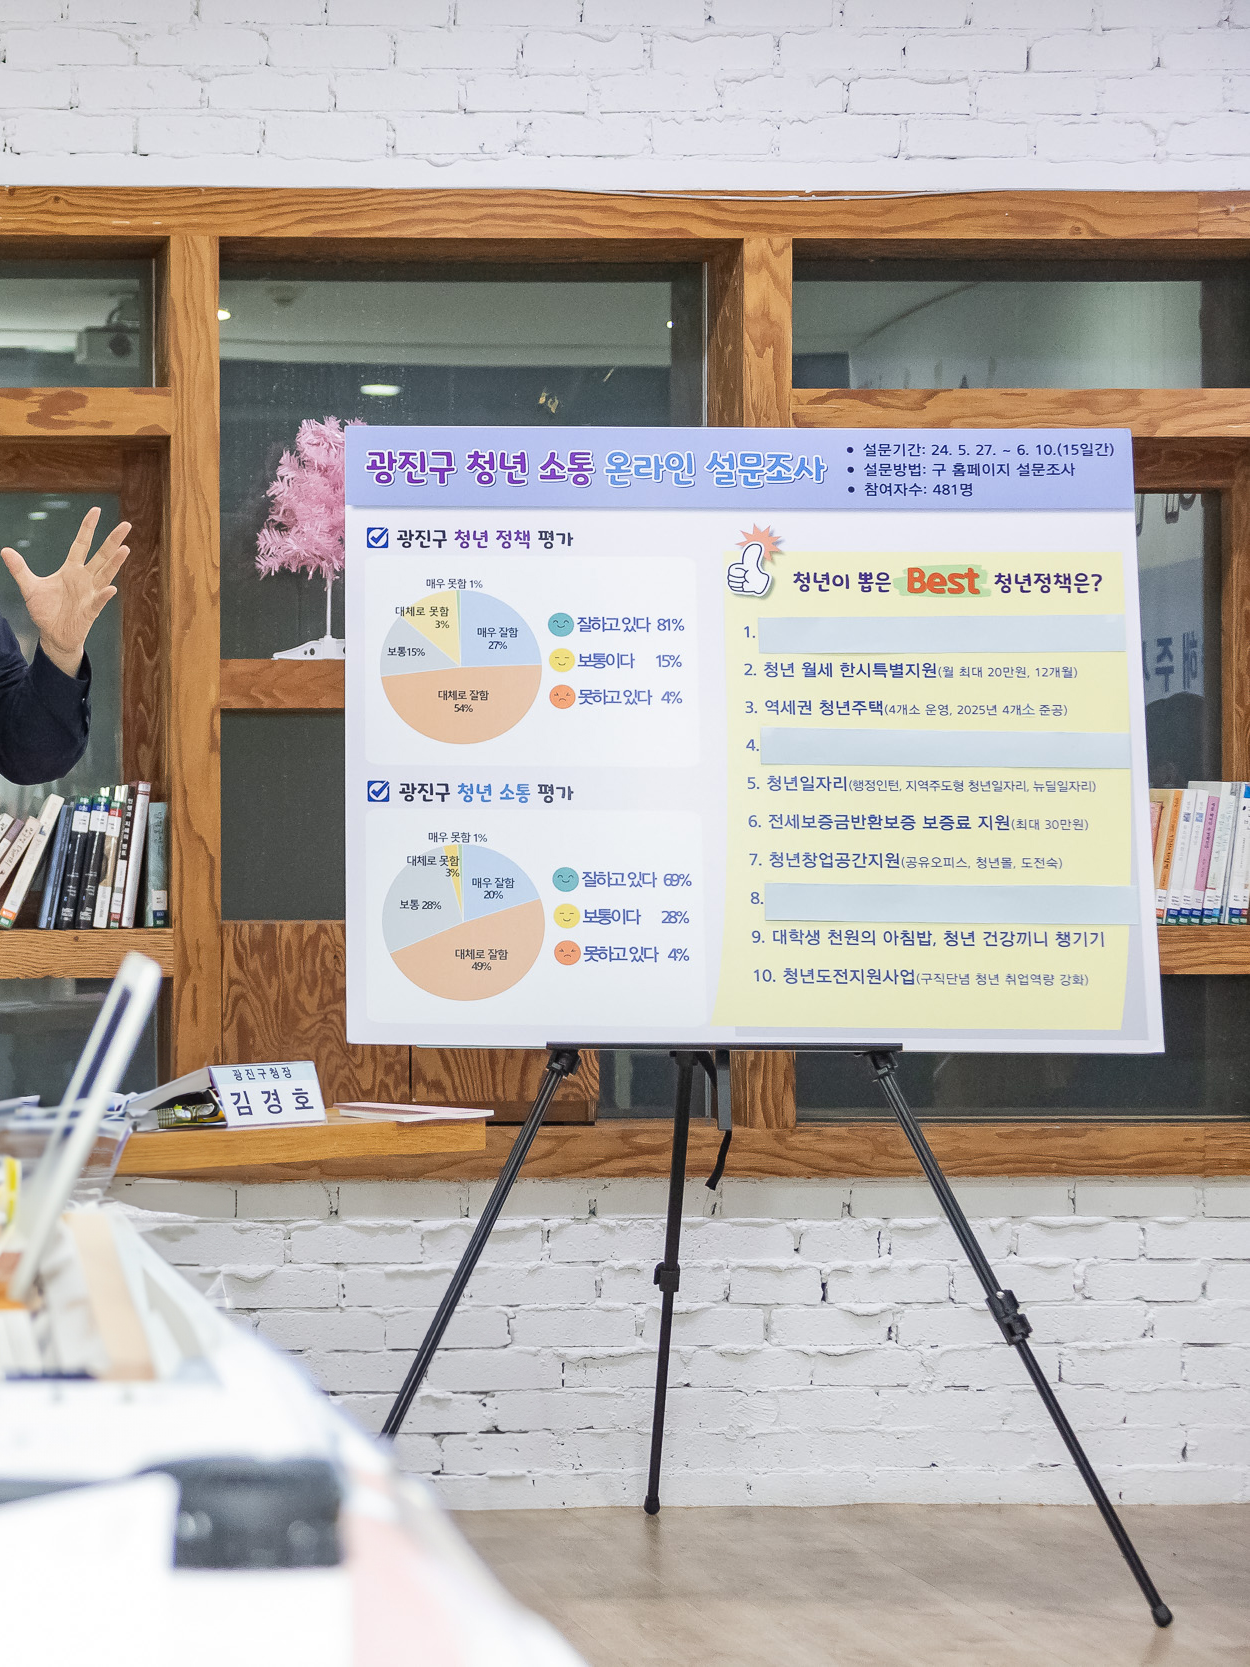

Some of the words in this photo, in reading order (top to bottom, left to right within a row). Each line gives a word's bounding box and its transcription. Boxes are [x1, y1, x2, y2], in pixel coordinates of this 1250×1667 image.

[863, 443, 925, 457] 설문기간:
[932, 445, 952, 455] 24.
[959, 445, 969, 455] 5.
[976, 445, 996, 455] 27.
[1017, 445, 1028, 455] 6.
[366, 451, 457, 487] 광진구
[466, 451, 529, 487] 청년
[538, 452, 596, 488] 소통
[603, 452, 696, 488] 온라인
[704, 452, 828, 489] 설문조사
[864, 463, 926, 477] 설문방법:
[932, 464, 946, 476] 구
[952, 463, 1009, 476] 홈페이지
[1016, 463, 1075, 476] 설문조사
[865, 483, 926, 496] 참여자수:
[933, 483, 972, 497] 481명
[397, 530, 447, 548] 광진구
[454, 530, 488, 548] 청년
[496, 530, 530, 549] 정책
[538, 531, 573, 549] 평가
[426, 579, 445, 589] 매우
[448, 579, 466, 589] 못함
[470, 580, 483, 588] 1%
[793, 572, 849, 592] 청년이
[858, 572, 891, 592] 뽑은
[907, 567, 980, 595] Best
[994, 573, 1102, 593] 청년정책은?
[396, 607, 425, 616] 대체로
[429, 606, 449, 617] 못함
[435, 620, 449, 628] 3%
[657, 619, 684, 631] 81%
[477, 627, 496, 637] 매우
[499, 627, 518, 638] 잘함
[744, 626, 755, 638] 1.
[489, 641, 507, 649] 27%
[578, 653, 635, 669] 보통이다
[656, 655, 682, 667] 15%
[744, 664, 756, 675] 2.
[764, 662, 794, 677] 청년
[802, 662, 832, 677] 월세
[960, 667, 982, 678] 최대
[988, 667, 1029, 678] 20만원,
[1036, 667, 1077, 678] 12개월)
[438, 690, 467, 700] 대체로
[470, 690, 489, 701] 잘함
[661, 691, 682, 704] 4%
[455, 704, 473, 712] 54%
[746, 701, 757, 713] 3.
[765, 700, 811, 715] 역세권
[925, 704, 952, 716] 운영,
[957, 705, 997, 715] 2025년
[1002, 704, 1035, 715] 4개소
[1039, 705, 1067, 716] 준공)
[746, 739, 759, 751] 4.
[748, 777, 759, 789] 5.
[906, 780, 963, 792] 지역주도형
[968, 780, 1029, 792] 청년일자리,
[399, 783, 450, 802] 광진구
[458, 783, 491, 802] 청년
[500, 784, 530, 803] 소통
[538, 784, 574, 803] 평가
[749, 815, 761, 827] 6.
[769, 814, 916, 830] 전세보증금반환보증
[923, 816, 971, 830] 보증료
[1045, 819, 1088, 830] 30만원)
[429, 832, 448, 842] 매우
[451, 832, 471, 843] 못함
[473, 834, 487, 842] 1%
[407, 855, 437, 866] 대체로
[439, 856, 459, 866] 못함
[749, 853, 762, 866] 7.
[446, 868, 460, 877] 3%
[472, 878, 493, 889] 매우
[495, 878, 515, 888] 잘함
[664, 874, 692, 886] 69%
[484, 890, 503, 899] 20%
[751, 892, 763, 904] 8.
[400, 899, 420, 910] 보통
[422, 901, 441, 909] 28%
[583, 909, 641, 925] 보통이다
[662, 911, 689, 924] 28%
[752, 931, 764, 943] 9.
[773, 929, 820, 945] 대학생
[828, 930, 875, 945] 천원의
[884, 930, 936, 946] 아침밥,
[944, 931, 975, 946] 청년
[983, 931, 1047, 947] 건강끼니
[1055, 932, 1104, 947] 챙기기
[455, 949, 485, 960] 대체로
[488, 949, 508, 960] 잘함
[668, 948, 689, 961] 4%
[472, 962, 491, 970] 49%
[754, 969, 775, 982] 10.
[976, 973, 999, 985] 청년
[1005, 974, 1054, 986] 취업역량
[1060, 974, 1088, 986] 강화)
[232, 1067, 291, 1081] 광진구청장
